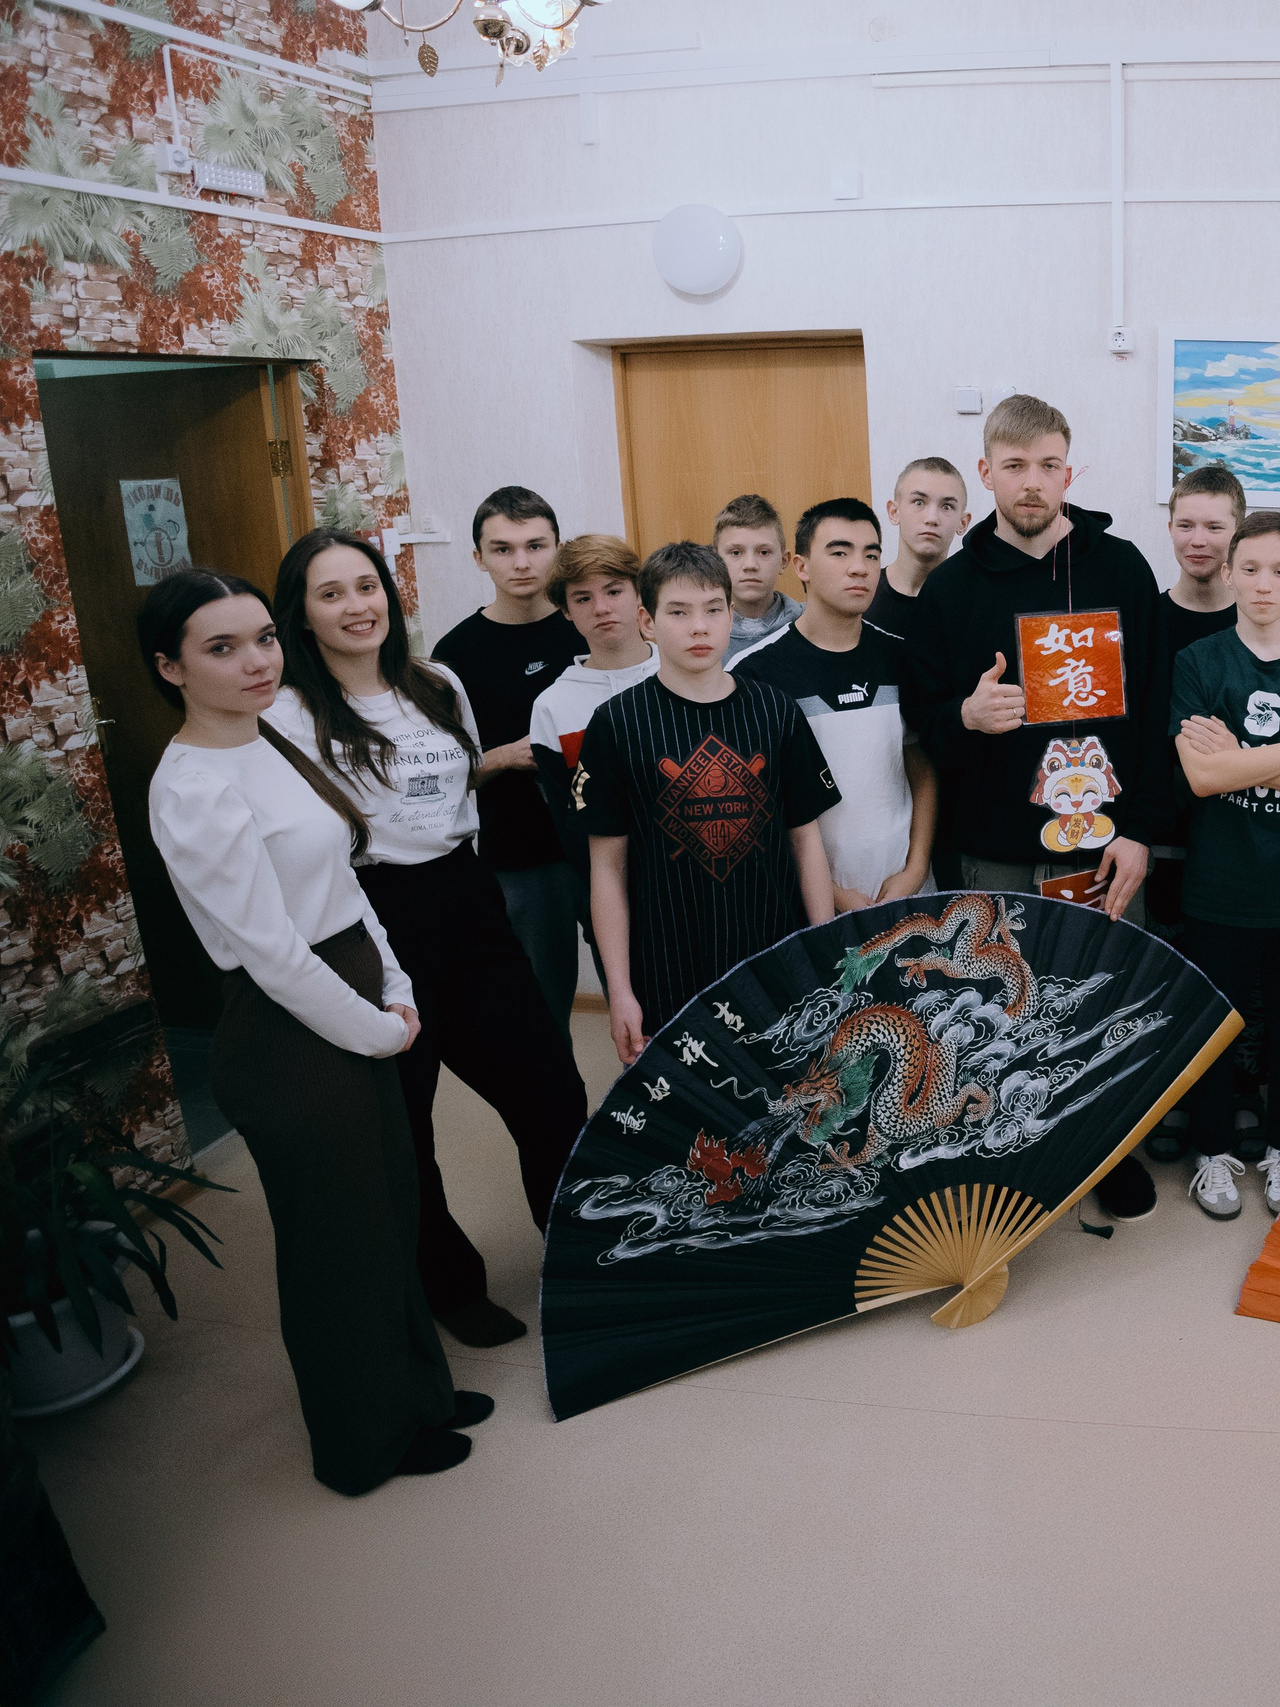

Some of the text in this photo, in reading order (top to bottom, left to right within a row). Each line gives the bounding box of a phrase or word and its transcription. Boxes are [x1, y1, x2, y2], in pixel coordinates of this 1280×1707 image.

[527, 661, 544, 671] NIKE
[1034, 623, 1106, 707] 如意
[837, 691, 865, 705] PUMA
[389, 728, 436, 743] WITH LOVE
[426, 751, 440, 764] DI
[444, 775, 454, 784] 62
[663, 753, 709, 804] YANKEE
[719, 752, 767, 802] STADIUM
[388, 802, 458, 824] the eternal city
[684, 802, 750, 816] NEW YORK
[428, 822, 445, 831] ITALIA
[707, 822, 731, 848] 1941
[729, 814, 763, 860] SERIES
[1069, 817, 1082, 840] 发财
[668, 818, 711, 861] WORLD
